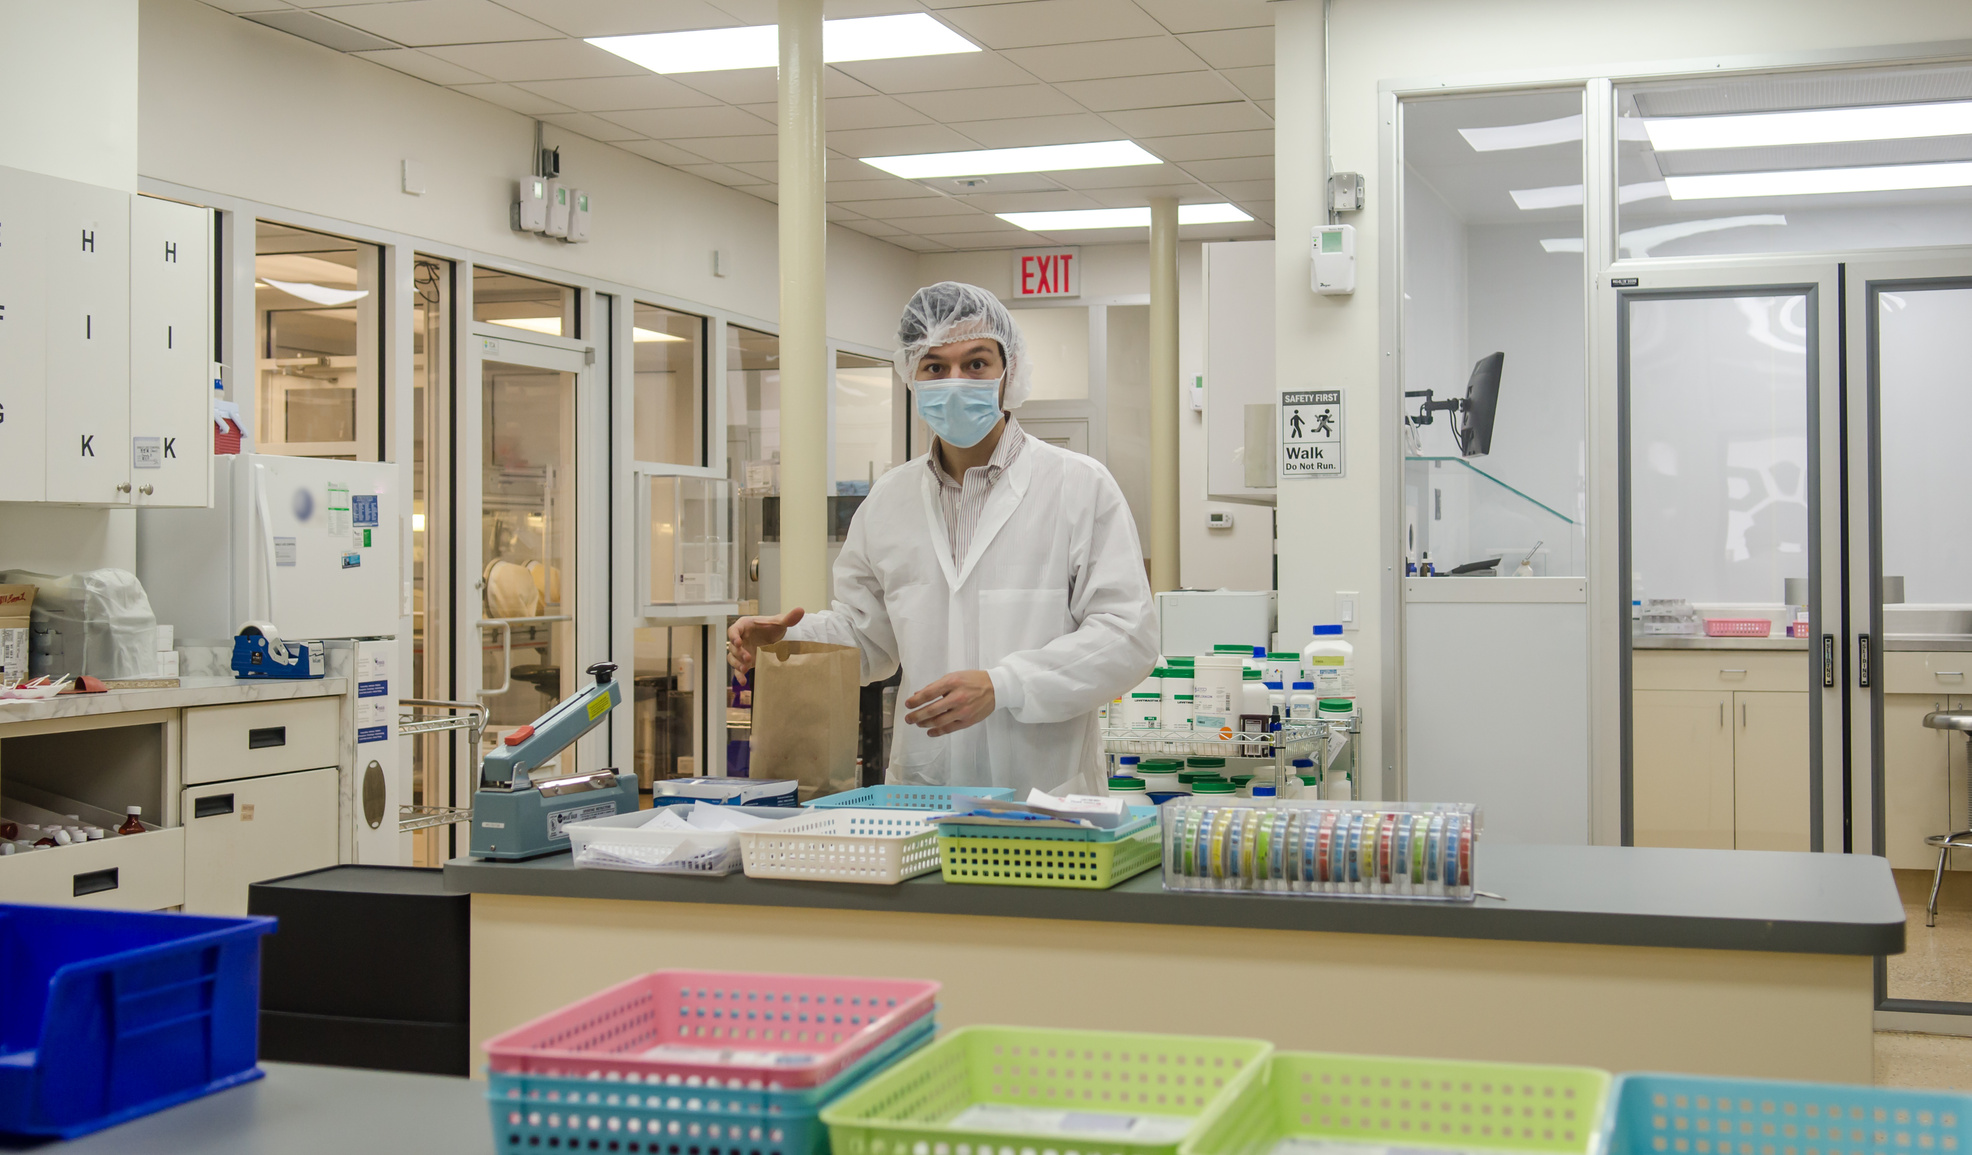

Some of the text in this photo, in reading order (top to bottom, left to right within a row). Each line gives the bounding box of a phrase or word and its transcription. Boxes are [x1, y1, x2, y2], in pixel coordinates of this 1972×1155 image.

[82, 229, 94, 253] H
[165, 241, 176, 263] H
[1022, 254, 1073, 295] EXIT
[1284, 393, 1338, 403] SAFETY FIRST
[81, 434, 95, 457] K
[164, 437, 176, 459] K
[1286, 446, 1324, 460] Walk
[1286, 461, 1336, 471] Do Not Run.
